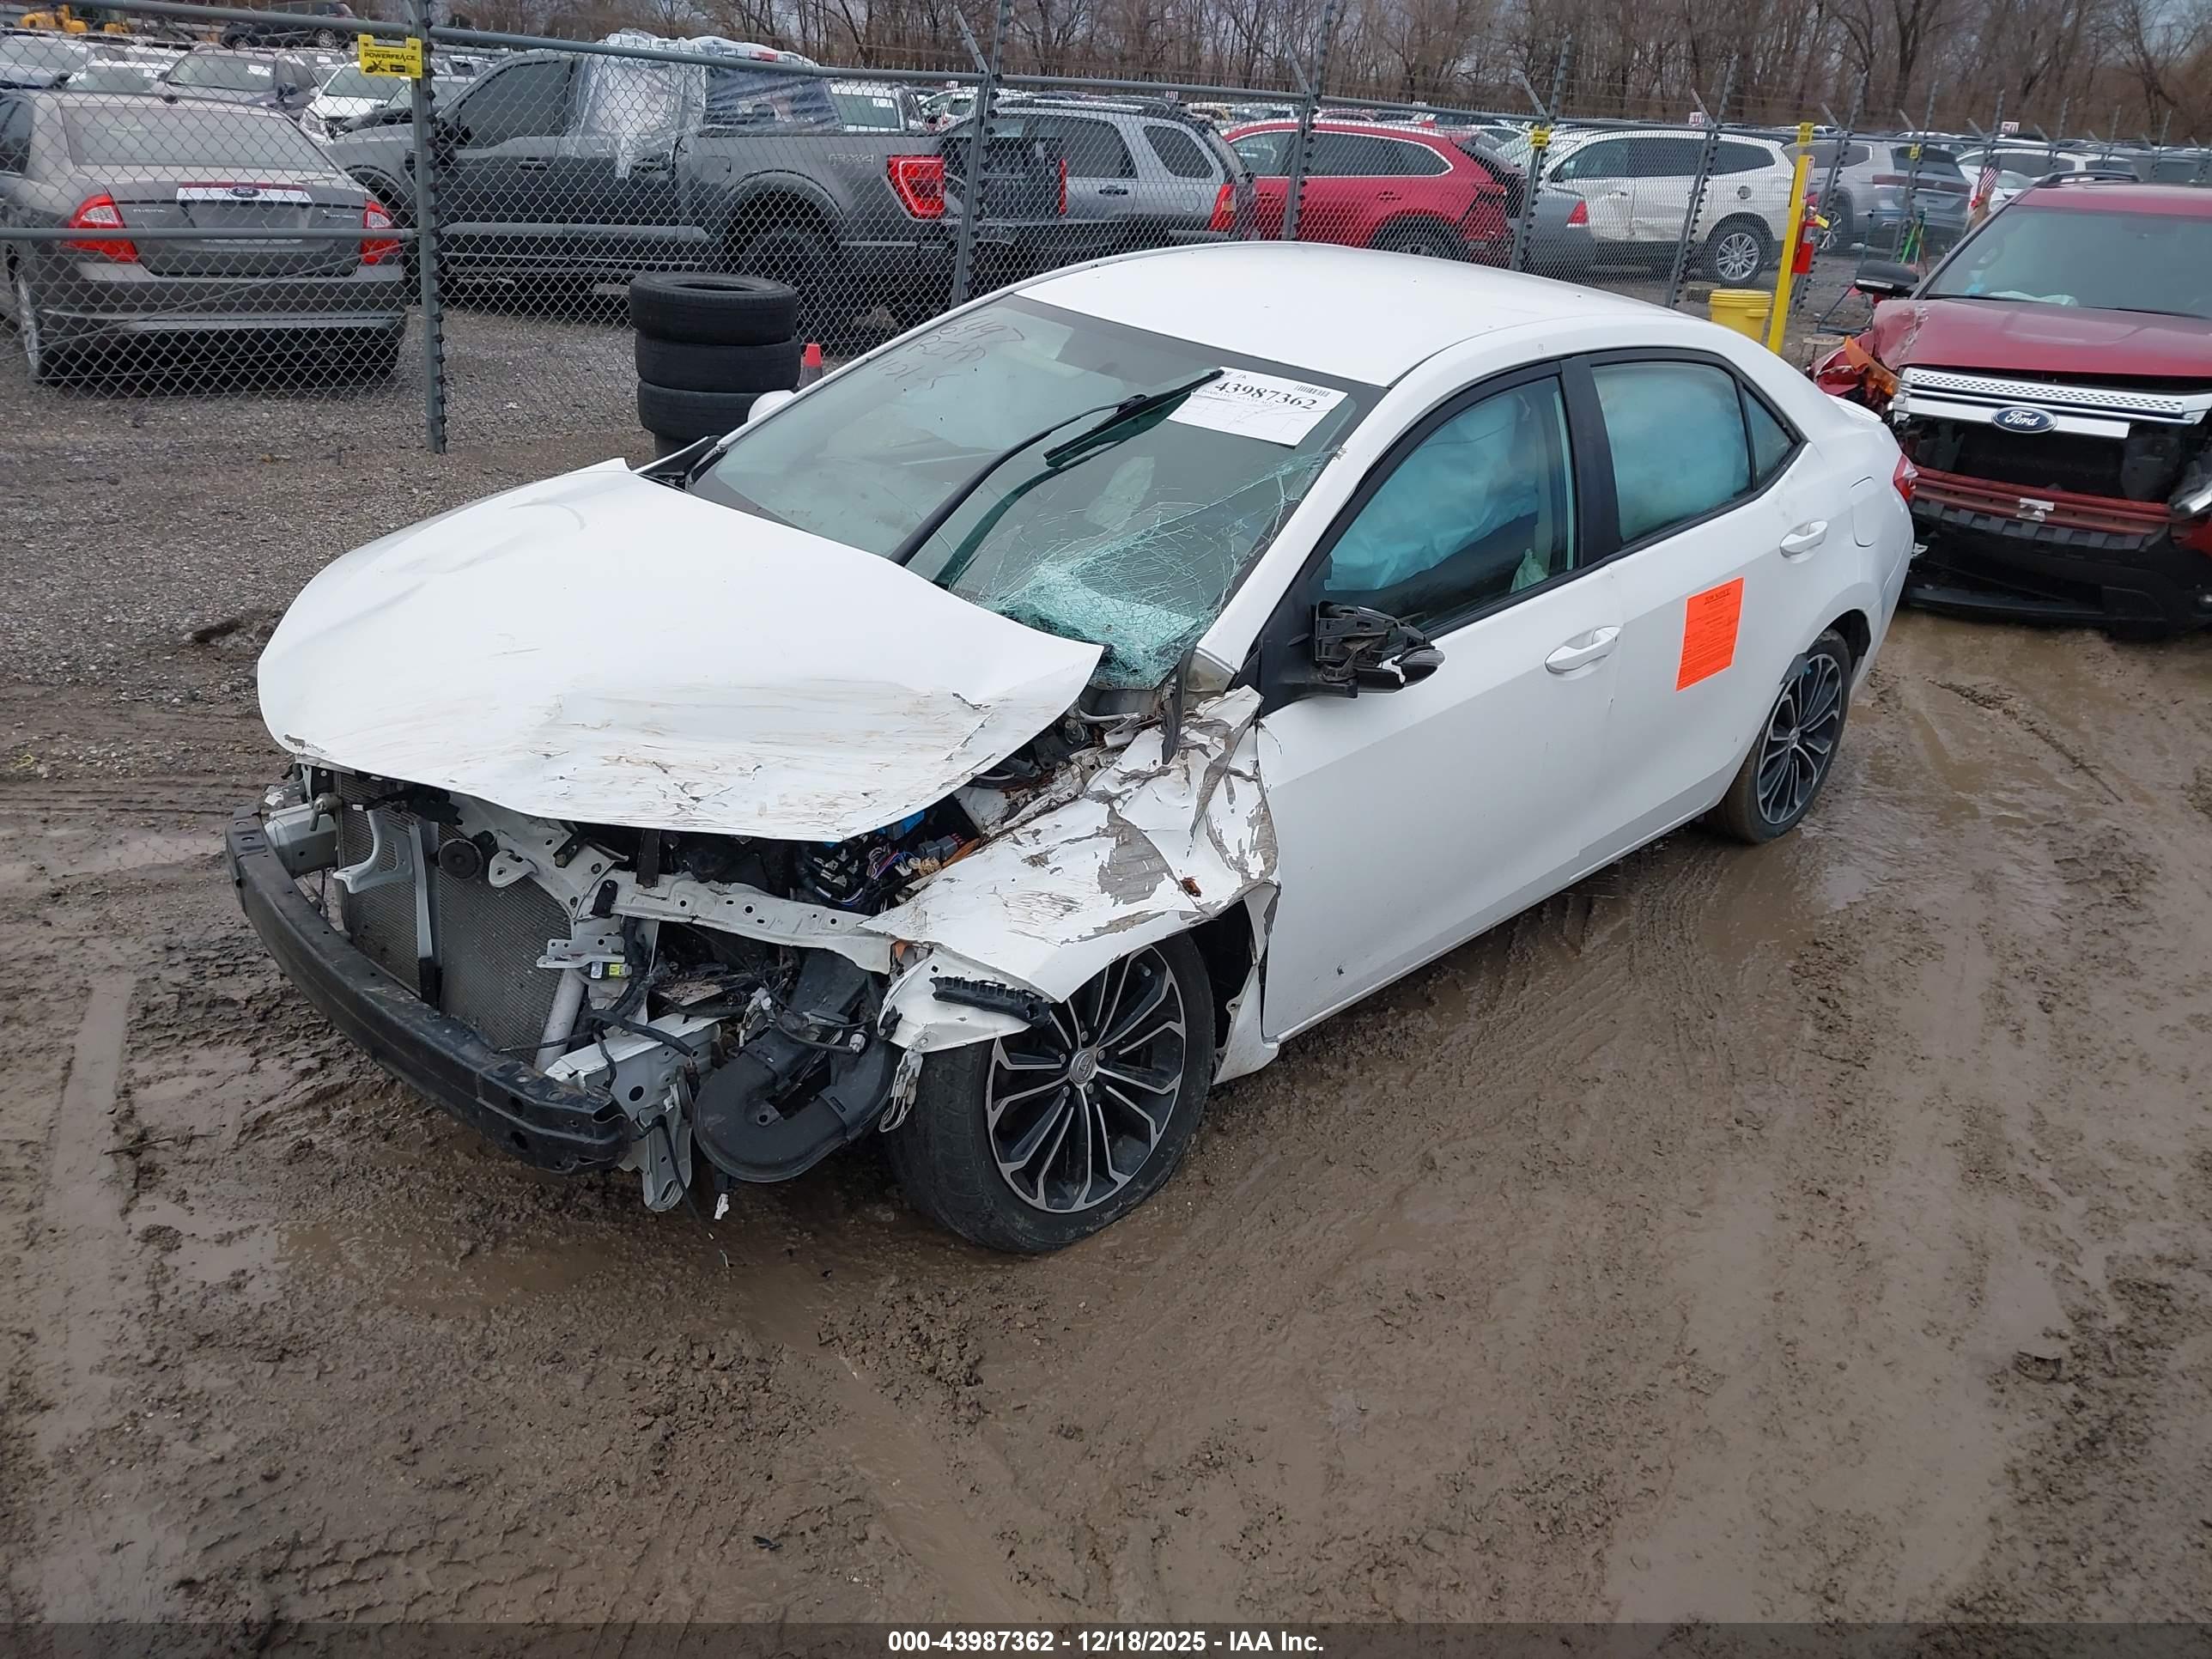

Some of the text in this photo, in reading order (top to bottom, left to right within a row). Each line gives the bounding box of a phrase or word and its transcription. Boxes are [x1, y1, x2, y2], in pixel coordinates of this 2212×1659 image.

[364, 52, 416, 62] POWERFENCE
[1215, 381, 1318, 410] 43987362
[2004, 410, 2041, 427] Ford
